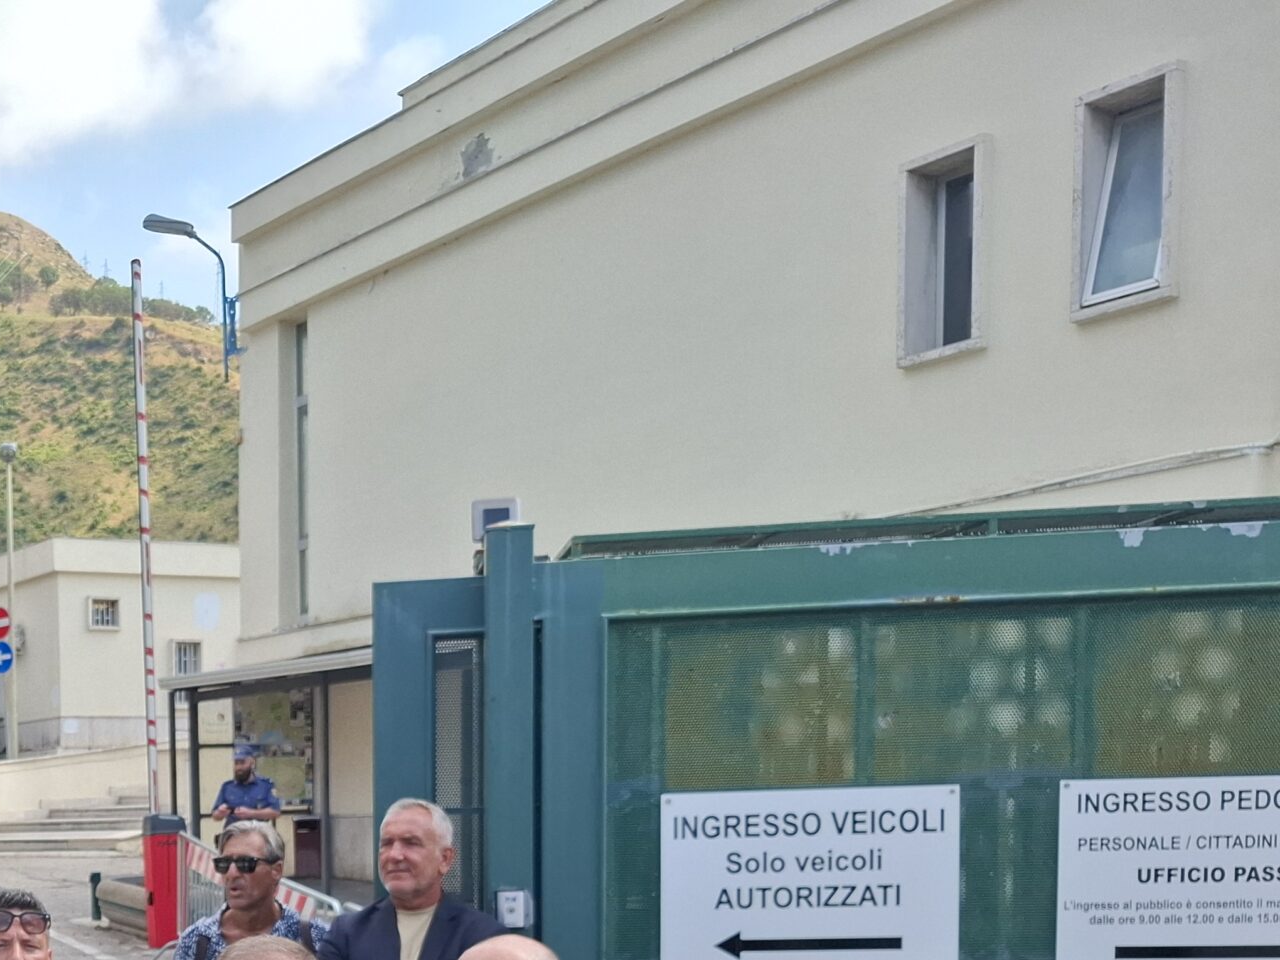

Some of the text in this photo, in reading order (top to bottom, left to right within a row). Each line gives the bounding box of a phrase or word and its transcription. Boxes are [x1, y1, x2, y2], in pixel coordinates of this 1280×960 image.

[1077, 791, 1211, 814] INGRESSO
[673, 808, 946, 840] INGRESSO VEICOLI
[1078, 834, 1278, 852] PERSONALE / CITTADINI
[725, 849, 883, 874] Solo veicoli
[1137, 867, 1225, 883] UFFICIO
[715, 884, 901, 910] AUTORIZZATI
[1064, 900, 1120, 913] L'ingresso
[1122, 900, 1133, 910] al
[1135, 900, 1183, 913] pubblico
[1186, 900, 1192, 910] è
[1196, 899, 1253, 909] consentito
[1256, 899, 1263, 909] il
[1089, 915, 1114, 925] dalle
[1118, 917, 1136, 925] ore
[1139, 915, 1161, 925] 9.00
[1164, 915, 1183, 925] alle
[1187, 914, 1215, 924] 12.00
[1218, 916, 1224, 924] e
[1227, 914, 1253, 924] dalle
